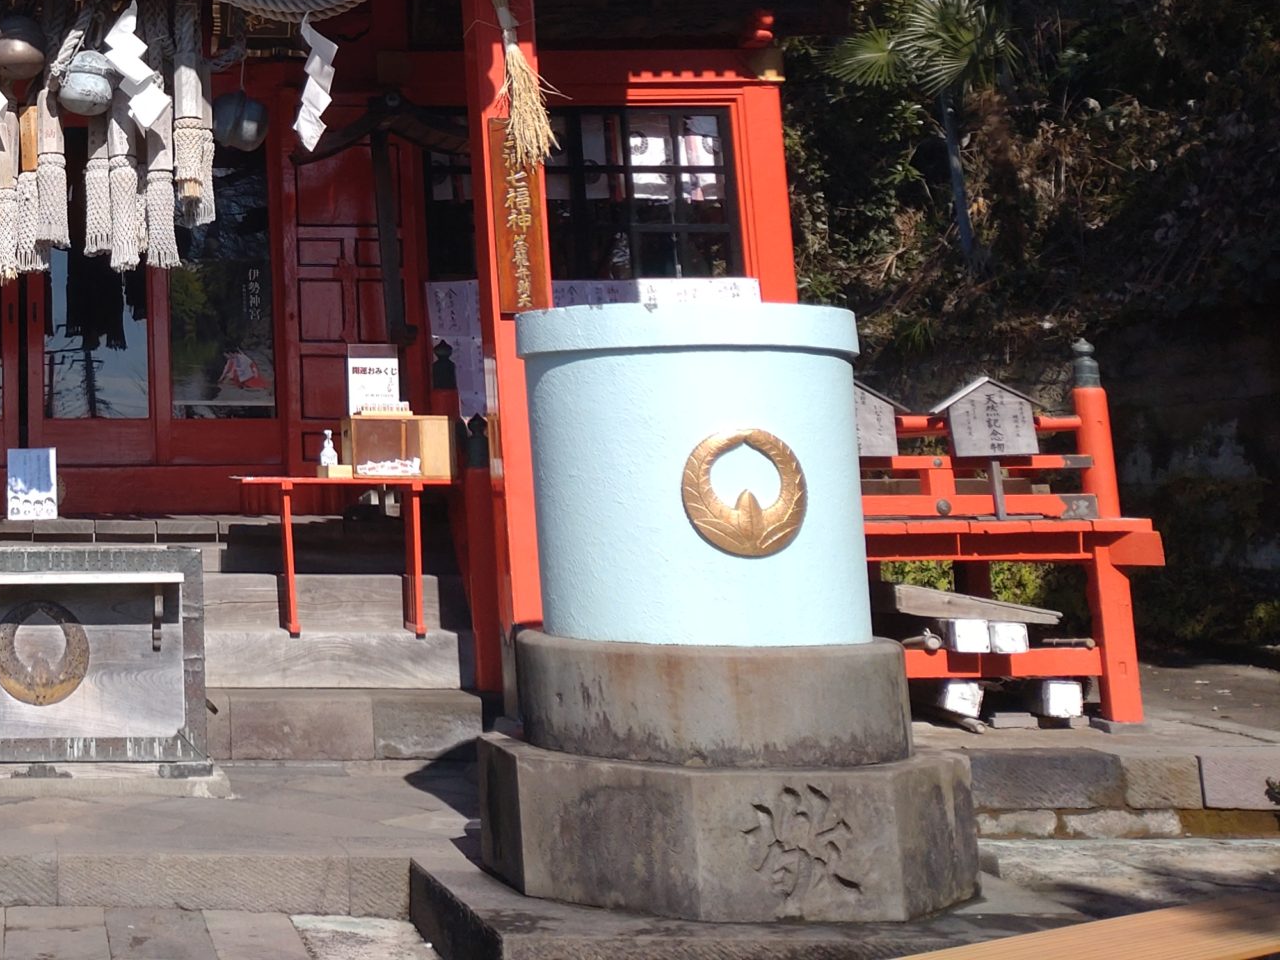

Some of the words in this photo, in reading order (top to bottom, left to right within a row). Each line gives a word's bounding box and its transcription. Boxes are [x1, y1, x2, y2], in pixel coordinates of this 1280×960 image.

[248, 268, 261, 320] 伊勢神宮
[351, 366, 398, 376] 開運おみくじ
[984, 393, 1006, 453] 天然記念物
